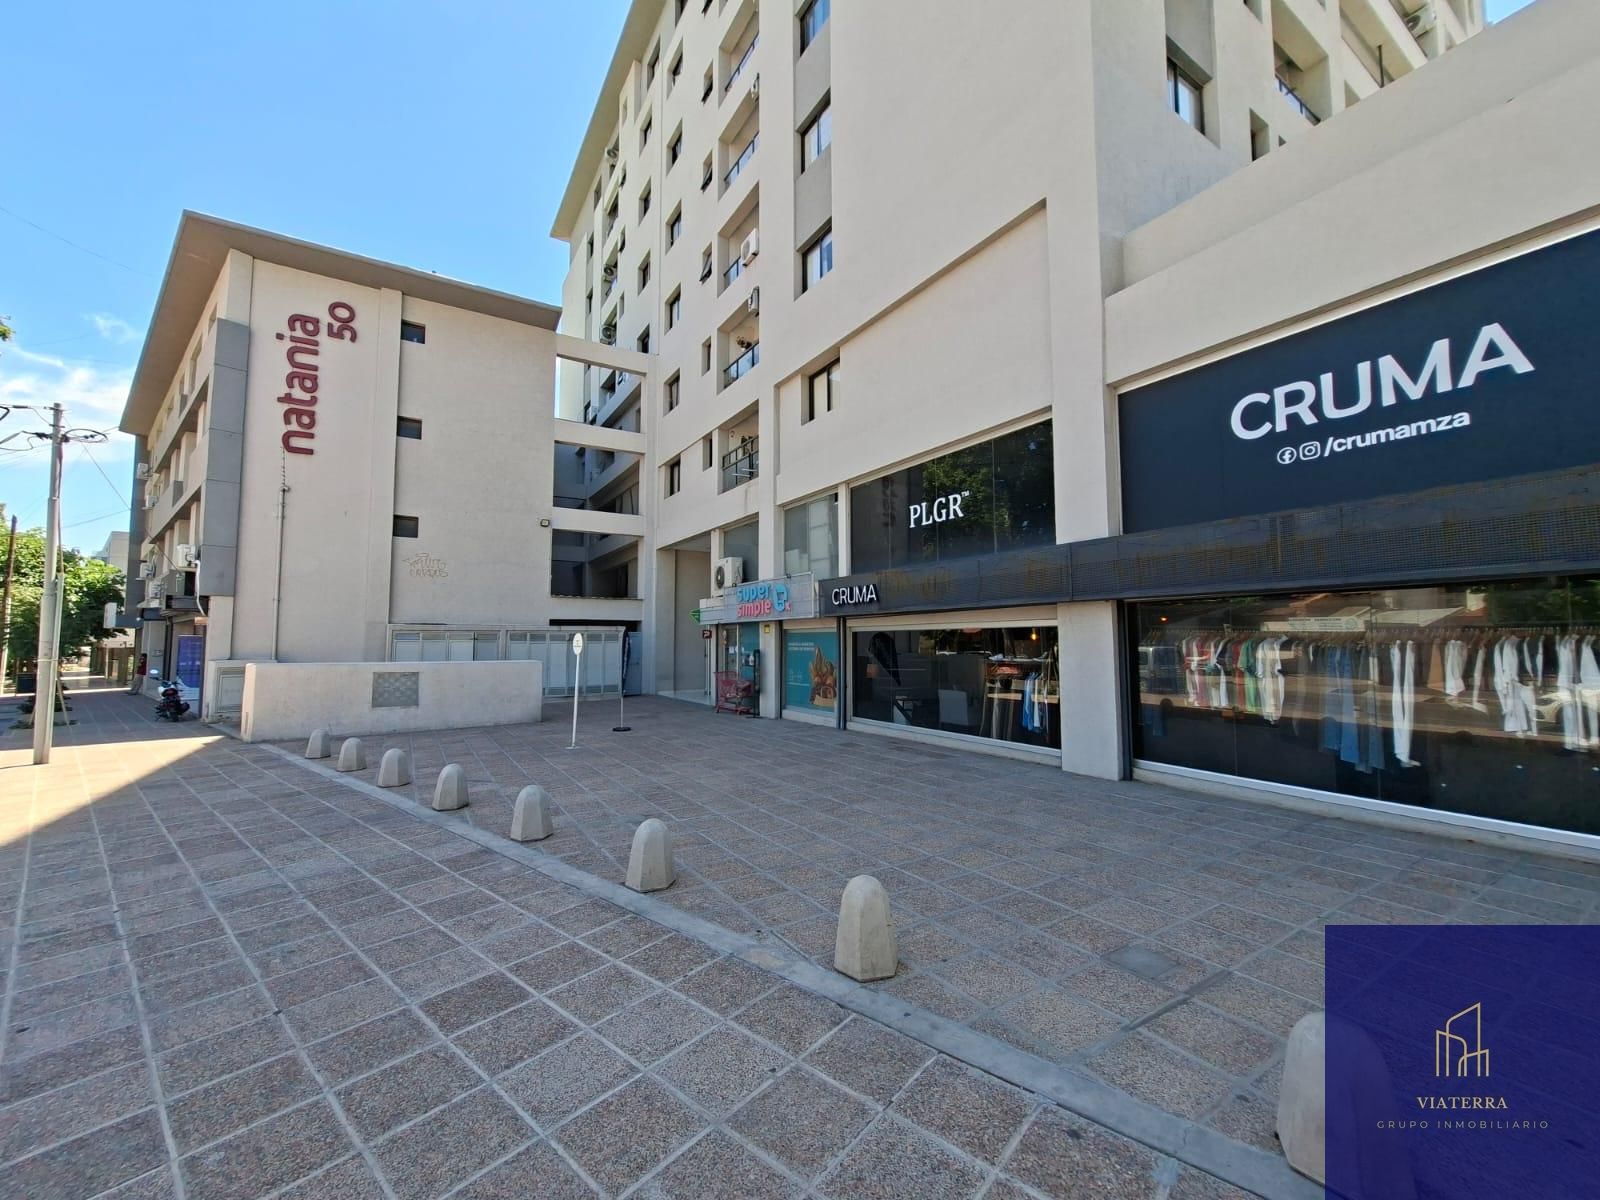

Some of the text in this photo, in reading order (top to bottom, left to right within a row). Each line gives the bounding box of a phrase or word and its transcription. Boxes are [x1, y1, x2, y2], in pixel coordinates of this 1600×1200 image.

[327, 301, 358, 344] 50
[275, 313, 320, 456] natania
[1230, 322, 1536, 440] CRUMA
[1323, 411, 1472, 457] /crumamza
[735, 582, 772, 602] super
[736, 599, 773, 618] simple
[831, 584, 877, 605] CRUMA
